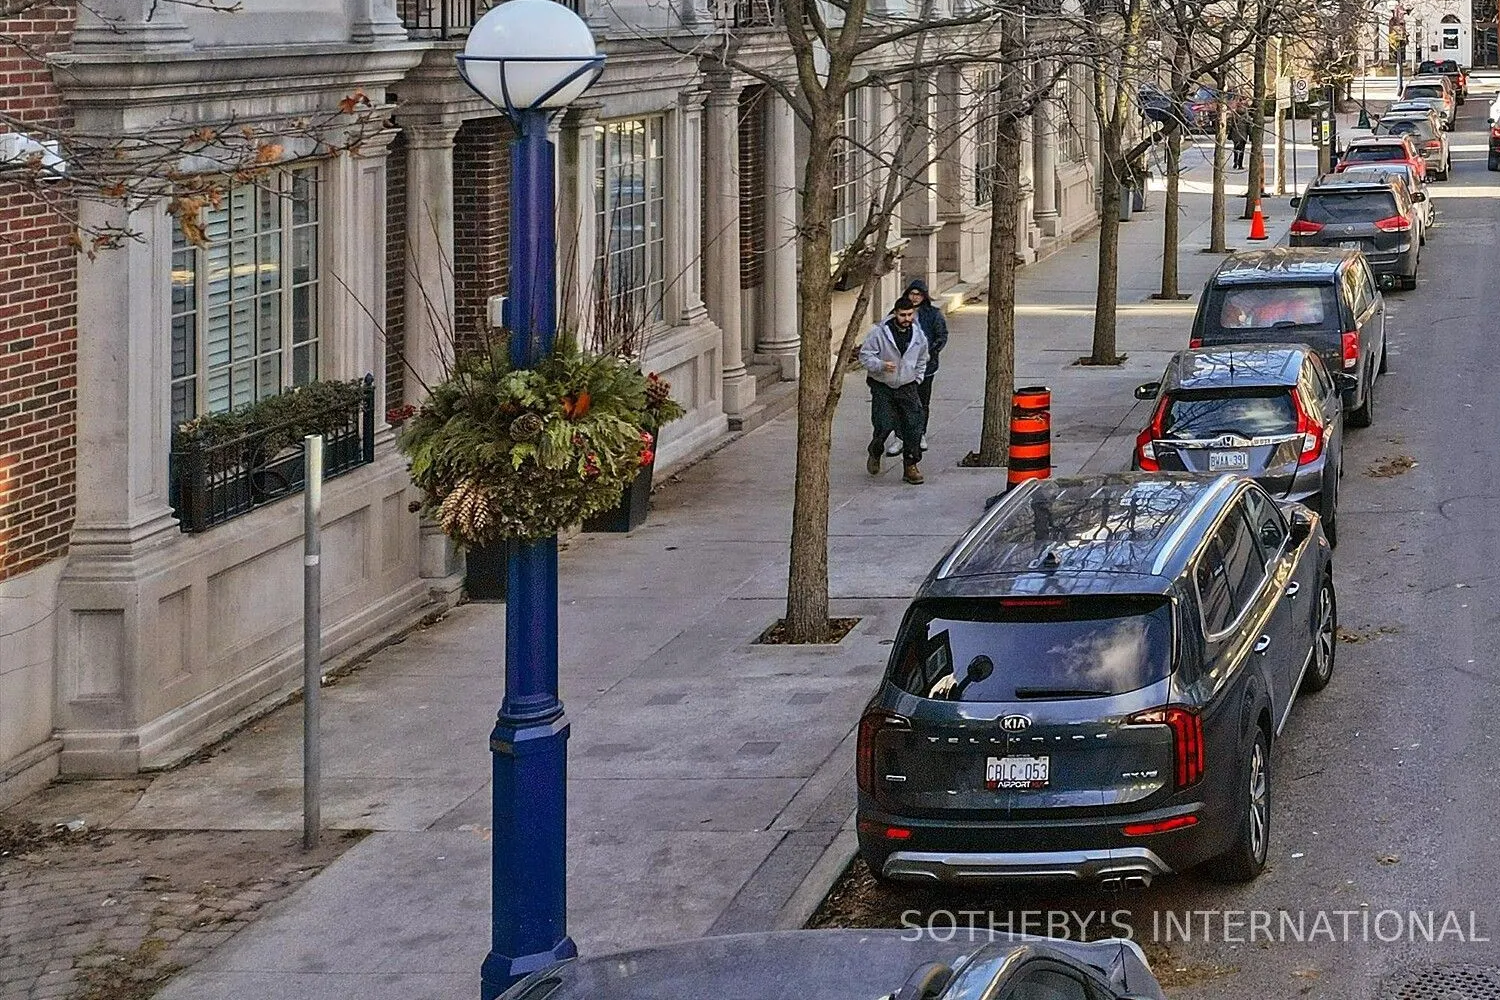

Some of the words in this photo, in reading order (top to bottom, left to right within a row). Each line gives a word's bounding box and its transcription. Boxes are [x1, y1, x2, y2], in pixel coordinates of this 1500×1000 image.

[1003, 719, 1027, 729] KIA
[988, 763, 1017, 780] CBLC
[1025, 763, 1047, 780] 053
